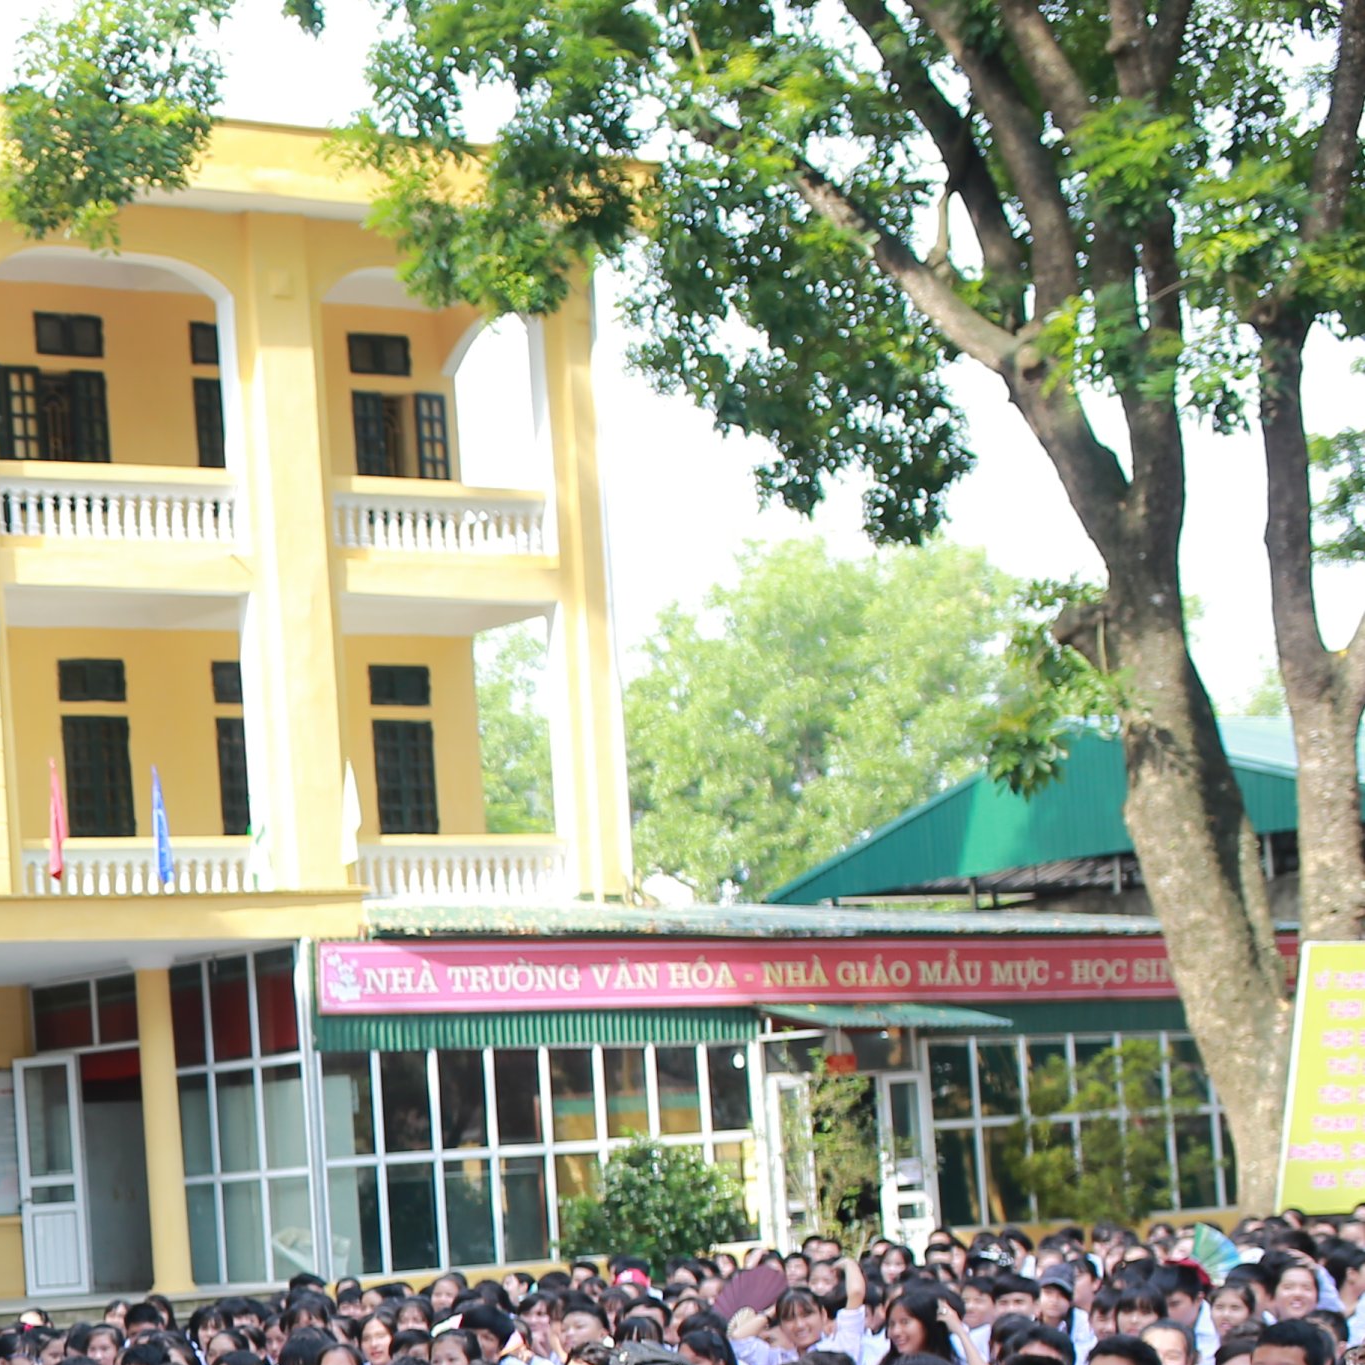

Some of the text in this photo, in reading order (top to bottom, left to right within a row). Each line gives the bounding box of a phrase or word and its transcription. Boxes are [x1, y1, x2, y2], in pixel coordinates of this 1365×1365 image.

[363, 959, 439, 994] NHÀ
[446, 957, 583, 993] TRƯỜNG
[589, 956, 660, 991] VĂN
[667, 954, 737, 990] HÓA
[761, 953, 830, 988] NHÀ
[835, 953, 912, 988] GIÁO
[917, 948, 982, 987] MẪU
[989, 957, 1050, 990] MỰC
[1070, 958, 1128, 989] HỌC
